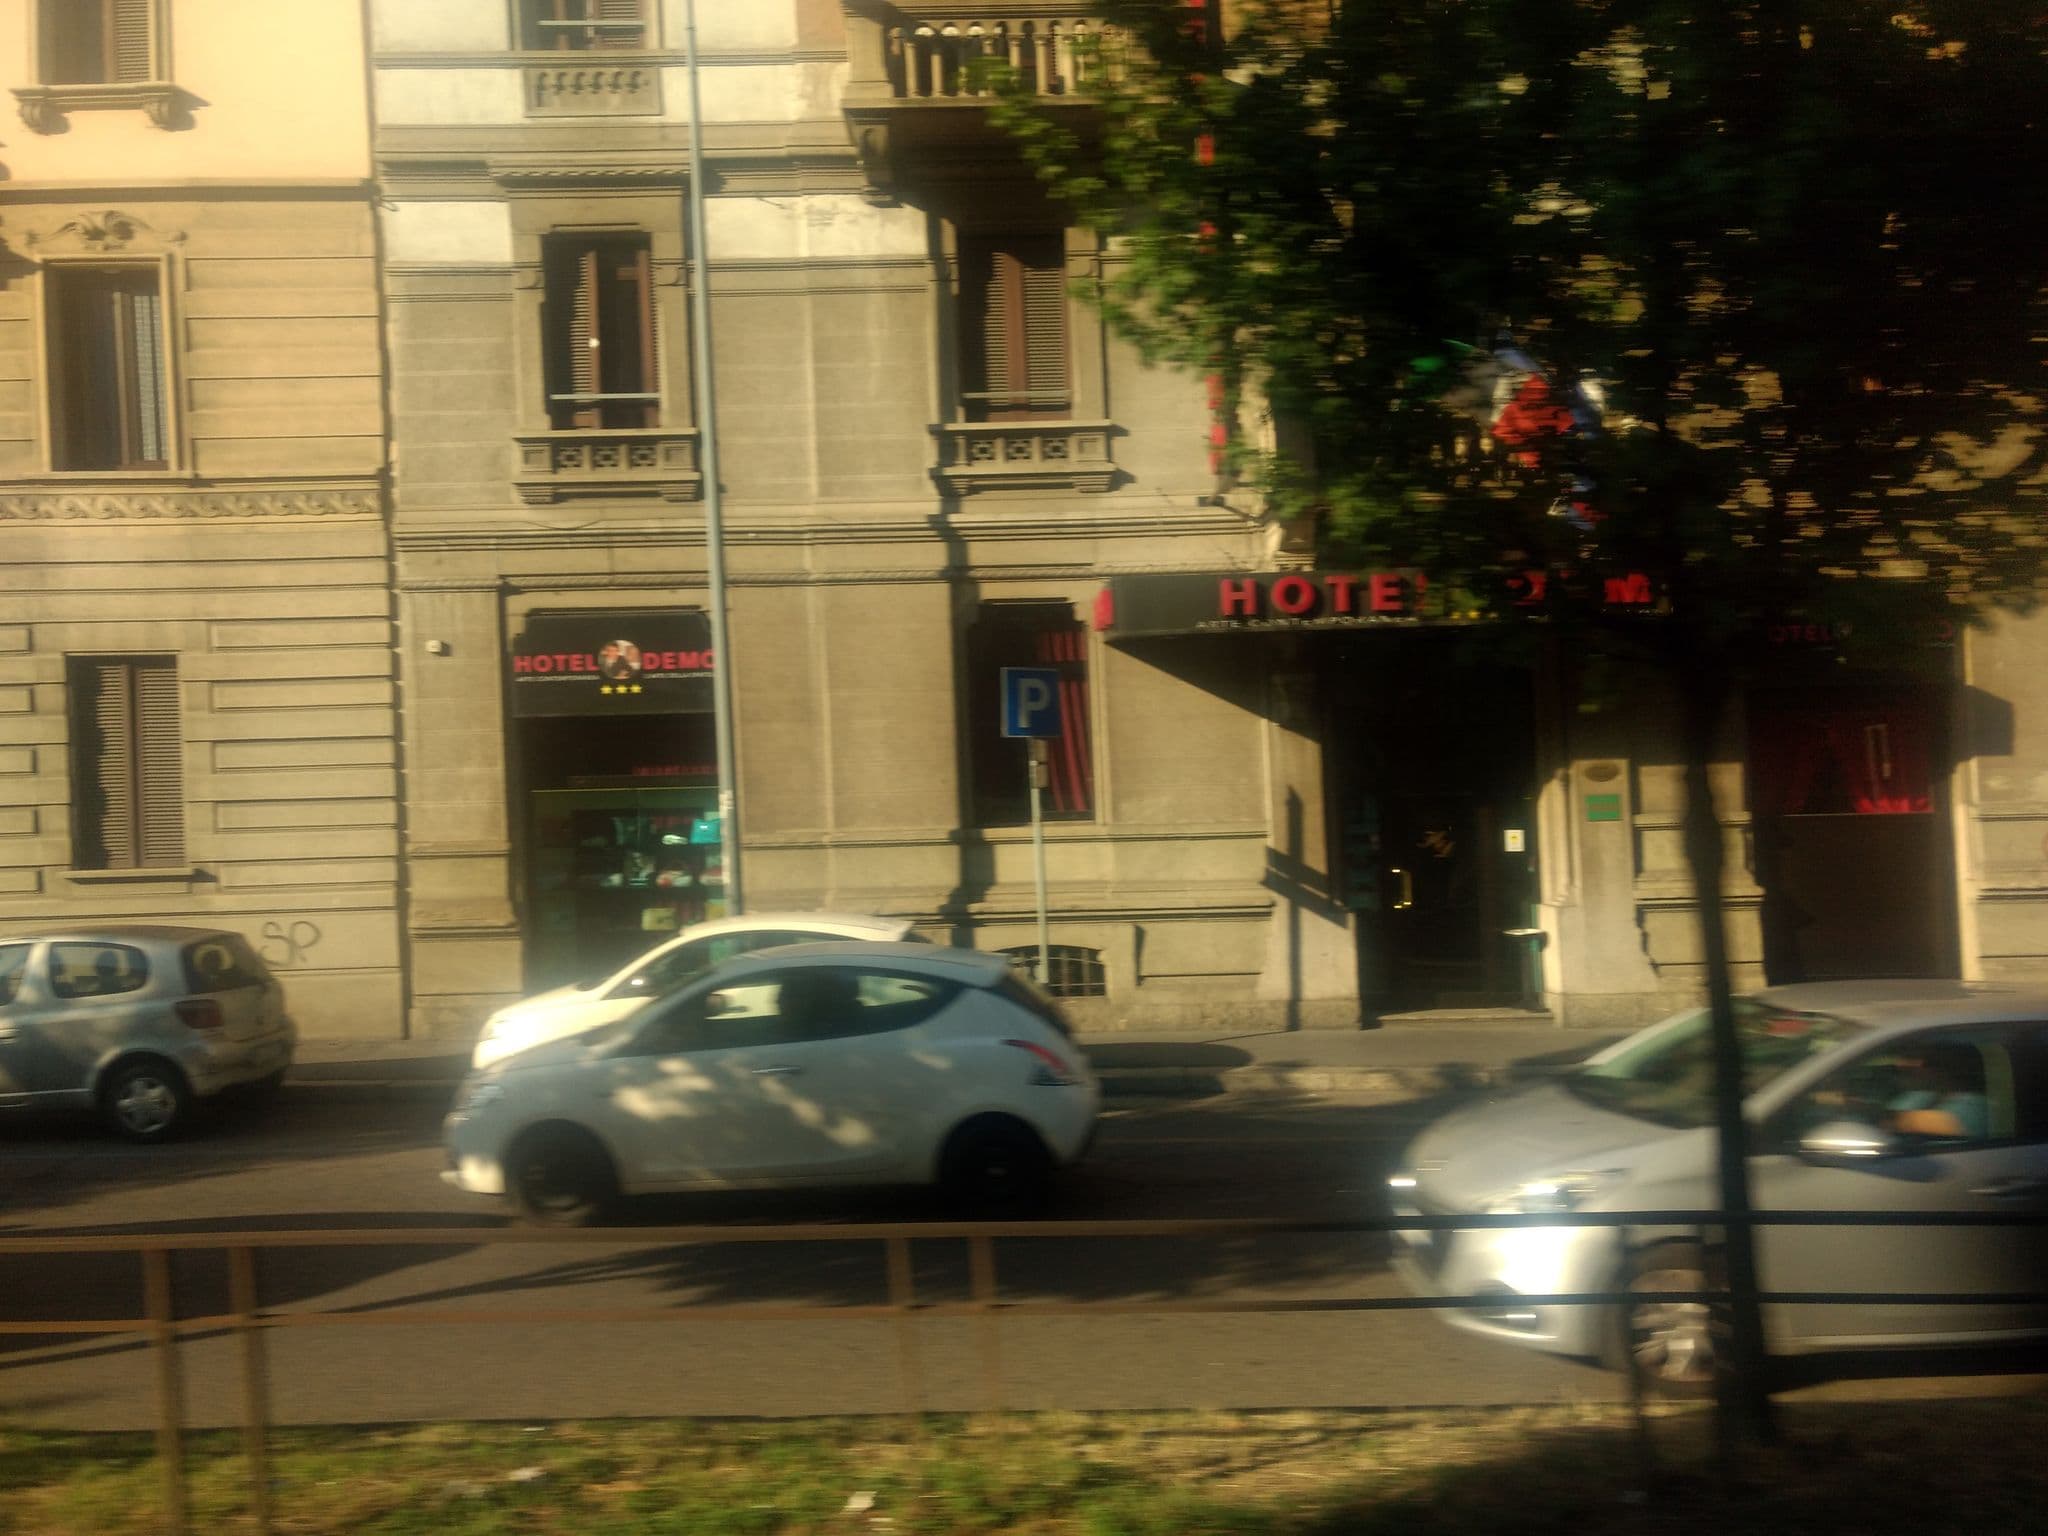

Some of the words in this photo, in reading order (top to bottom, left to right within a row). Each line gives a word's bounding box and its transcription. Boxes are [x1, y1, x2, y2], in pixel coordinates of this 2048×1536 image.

[513, 653, 600, 673] HOTEL
[1018, 678, 1051, 728] P
[261, 920, 322, 966] SP
